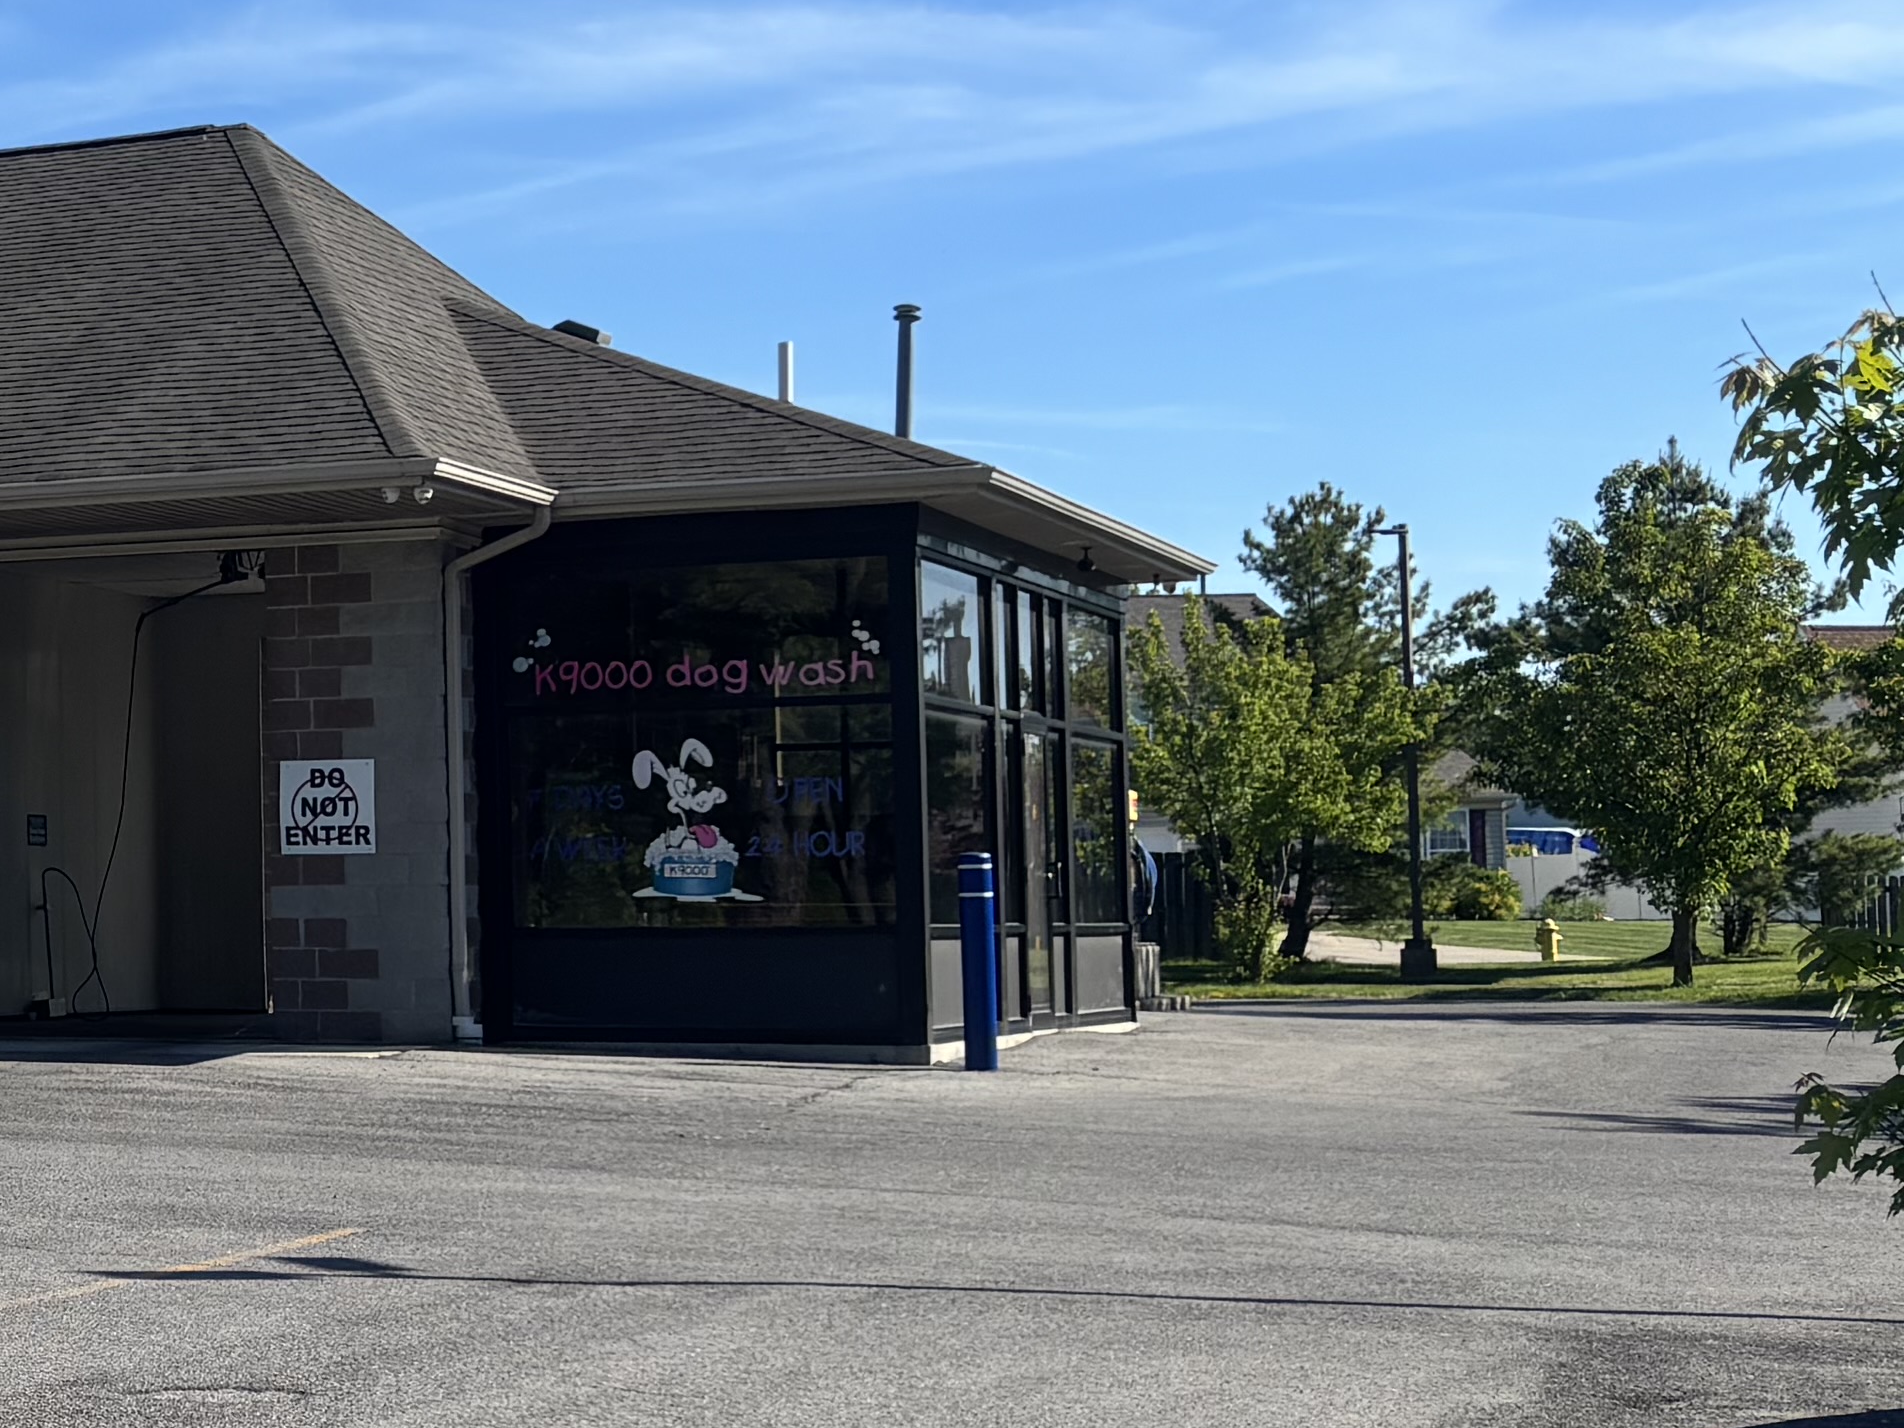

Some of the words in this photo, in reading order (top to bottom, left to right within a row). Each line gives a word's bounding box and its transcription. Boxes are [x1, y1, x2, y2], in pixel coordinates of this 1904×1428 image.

[534, 659, 652, 696] K9000
[667, 653, 747, 694] dog
[760, 650, 876, 689] wash
[310, 768, 345, 788] DO
[301, 797, 354, 817] NOT
[285, 825, 371, 846] ENTER
[794, 830, 866, 858] HOUR
